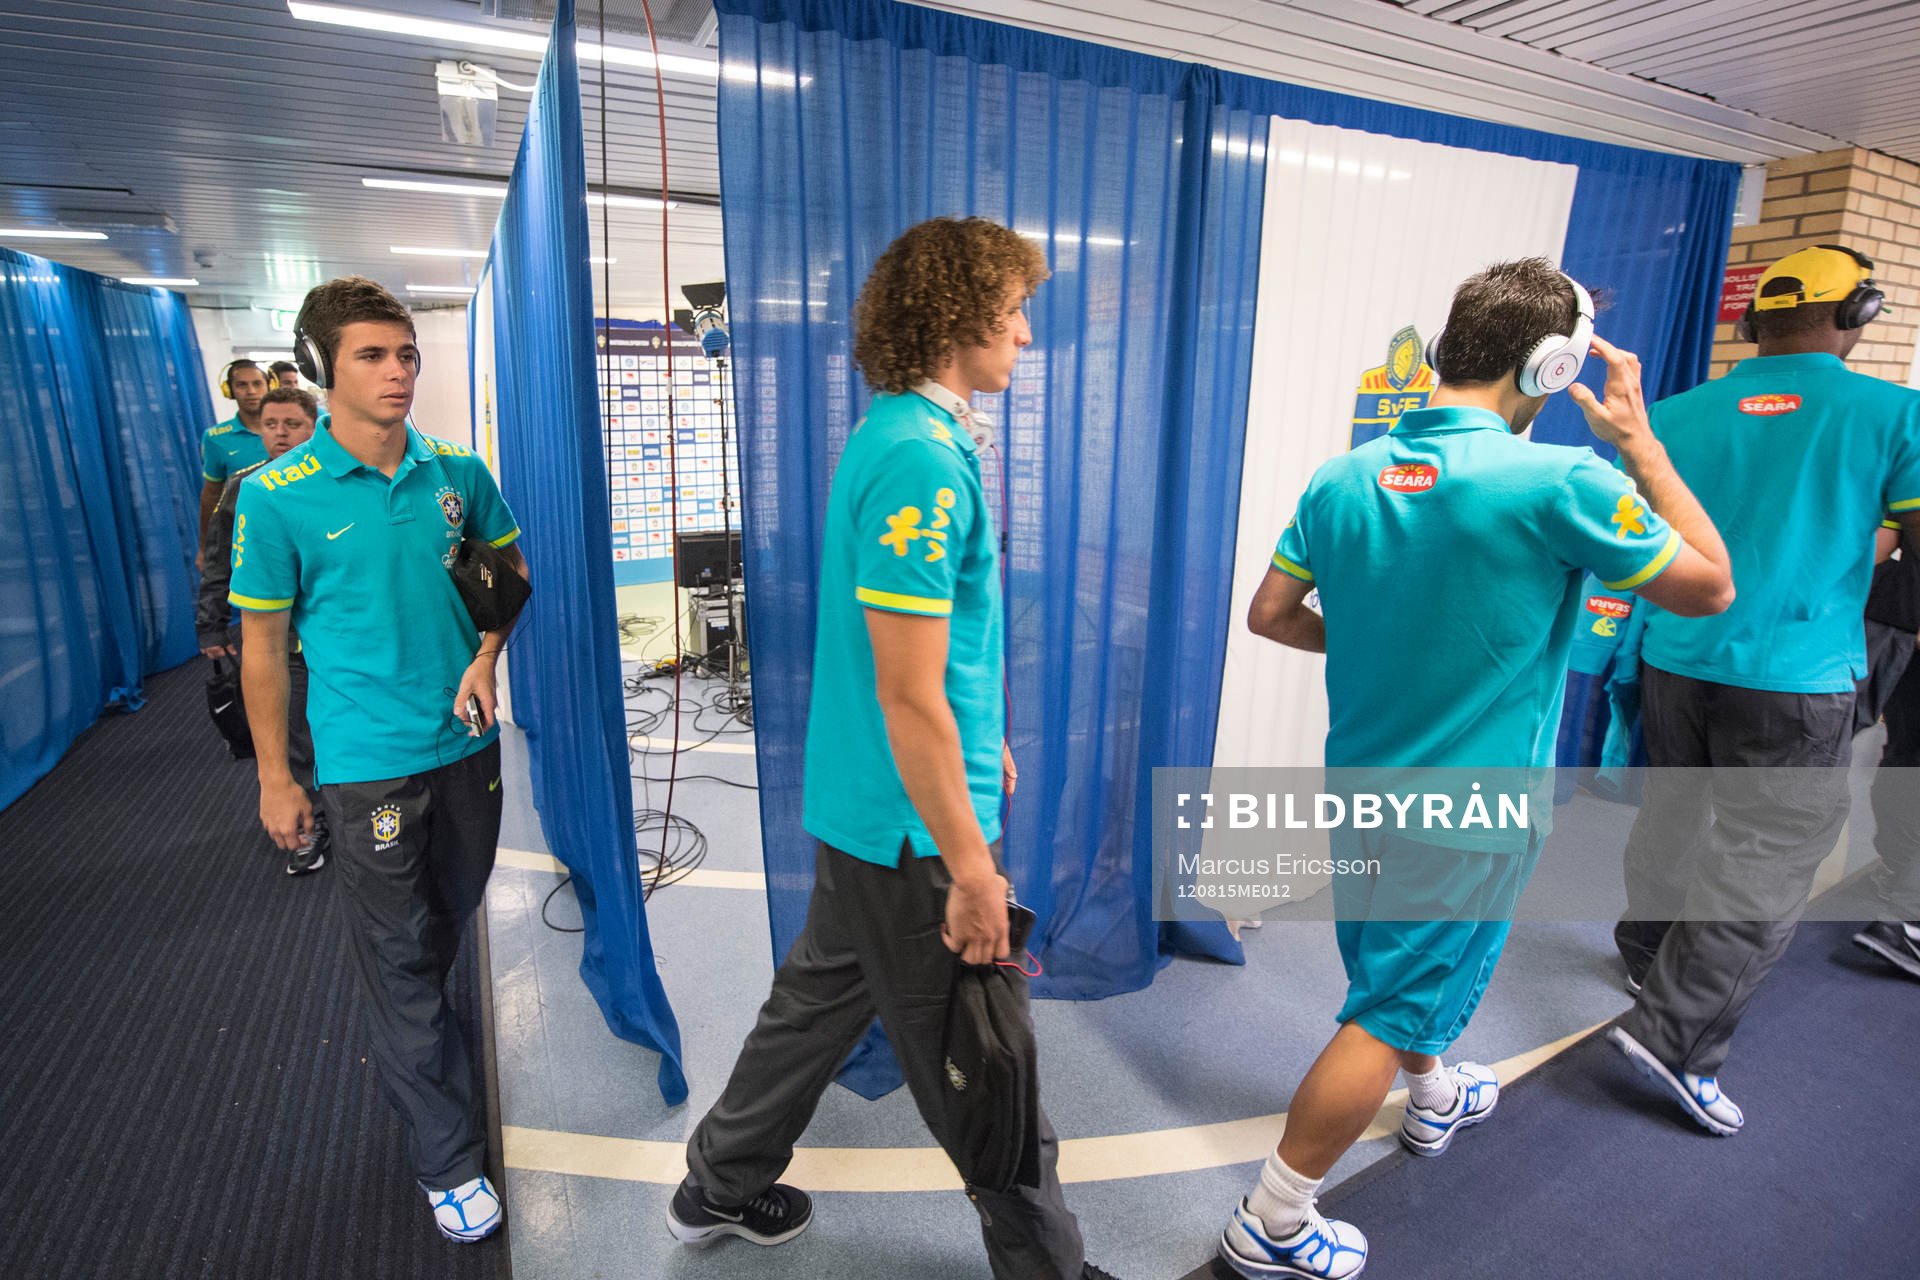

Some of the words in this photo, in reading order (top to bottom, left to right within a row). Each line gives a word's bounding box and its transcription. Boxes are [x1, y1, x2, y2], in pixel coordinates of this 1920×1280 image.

[1742, 402, 1797, 412] SEARA
[259, 453, 322, 491] Itaú
[1381, 474, 1433, 487] SEARA
[1589, 598, 1631, 613] SEARA
